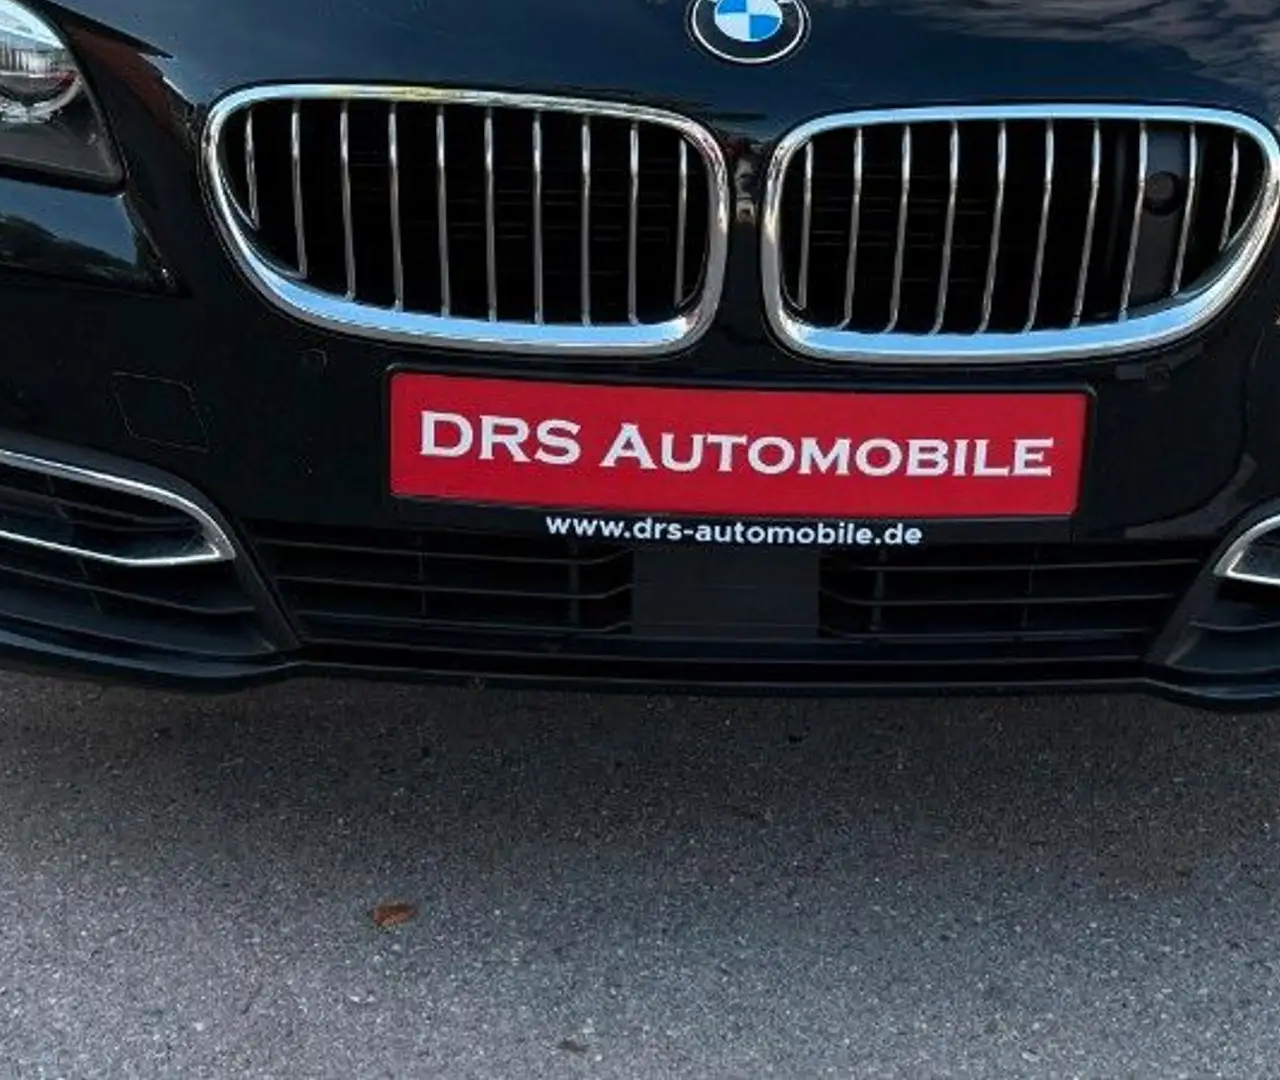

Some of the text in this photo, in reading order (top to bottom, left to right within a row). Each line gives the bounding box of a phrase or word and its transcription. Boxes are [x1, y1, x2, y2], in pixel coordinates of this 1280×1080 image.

[418, 410, 1054, 477] DRS AUTOMOBILE
[546, 516, 923, 545] www.drs-automobile.de
